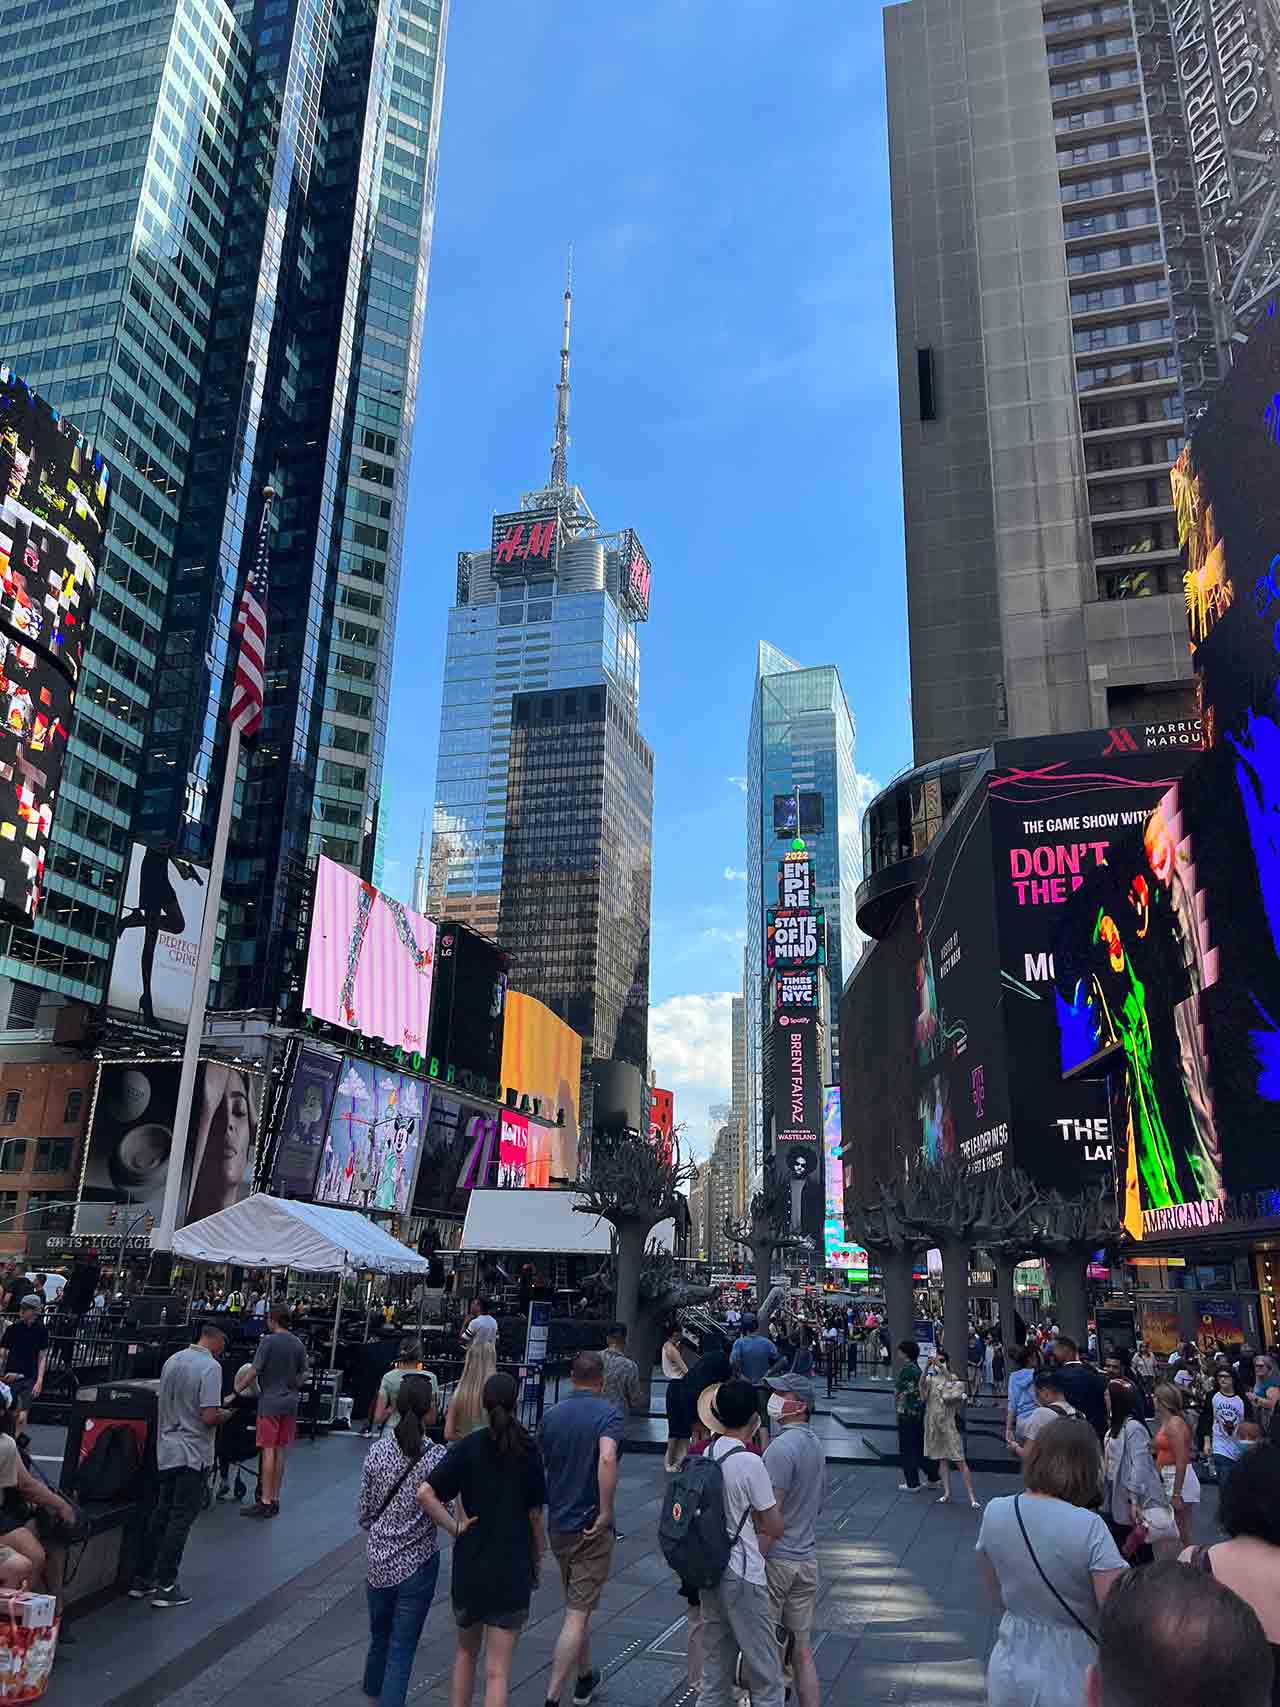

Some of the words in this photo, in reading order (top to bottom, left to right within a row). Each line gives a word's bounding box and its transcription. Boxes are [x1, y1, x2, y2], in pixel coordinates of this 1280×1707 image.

[1171, 0, 1230, 208] AMERICAN
[496, 521, 557, 563] H&M
[1023, 820, 1044, 834] THE
[1046, 816, 1080, 832] GAME
[1082, 813, 1119, 829] SHOW
[784, 852, 809, 860] 2022
[1010, 842, 1110, 878] DON'T
[1012, 877, 1068, 905] THE
[775, 917, 816, 938] STATE
[775, 929, 798, 944] OF
[441, 949, 453, 957] LG
[775, 937, 816, 958] MIND
[782, 991, 812, 1002] NYC
[790, 1033, 802, 1076] BRENT
[1057, 1119, 1108, 1140] THE
[1142, 1202, 1205, 1233] AMERICAN
